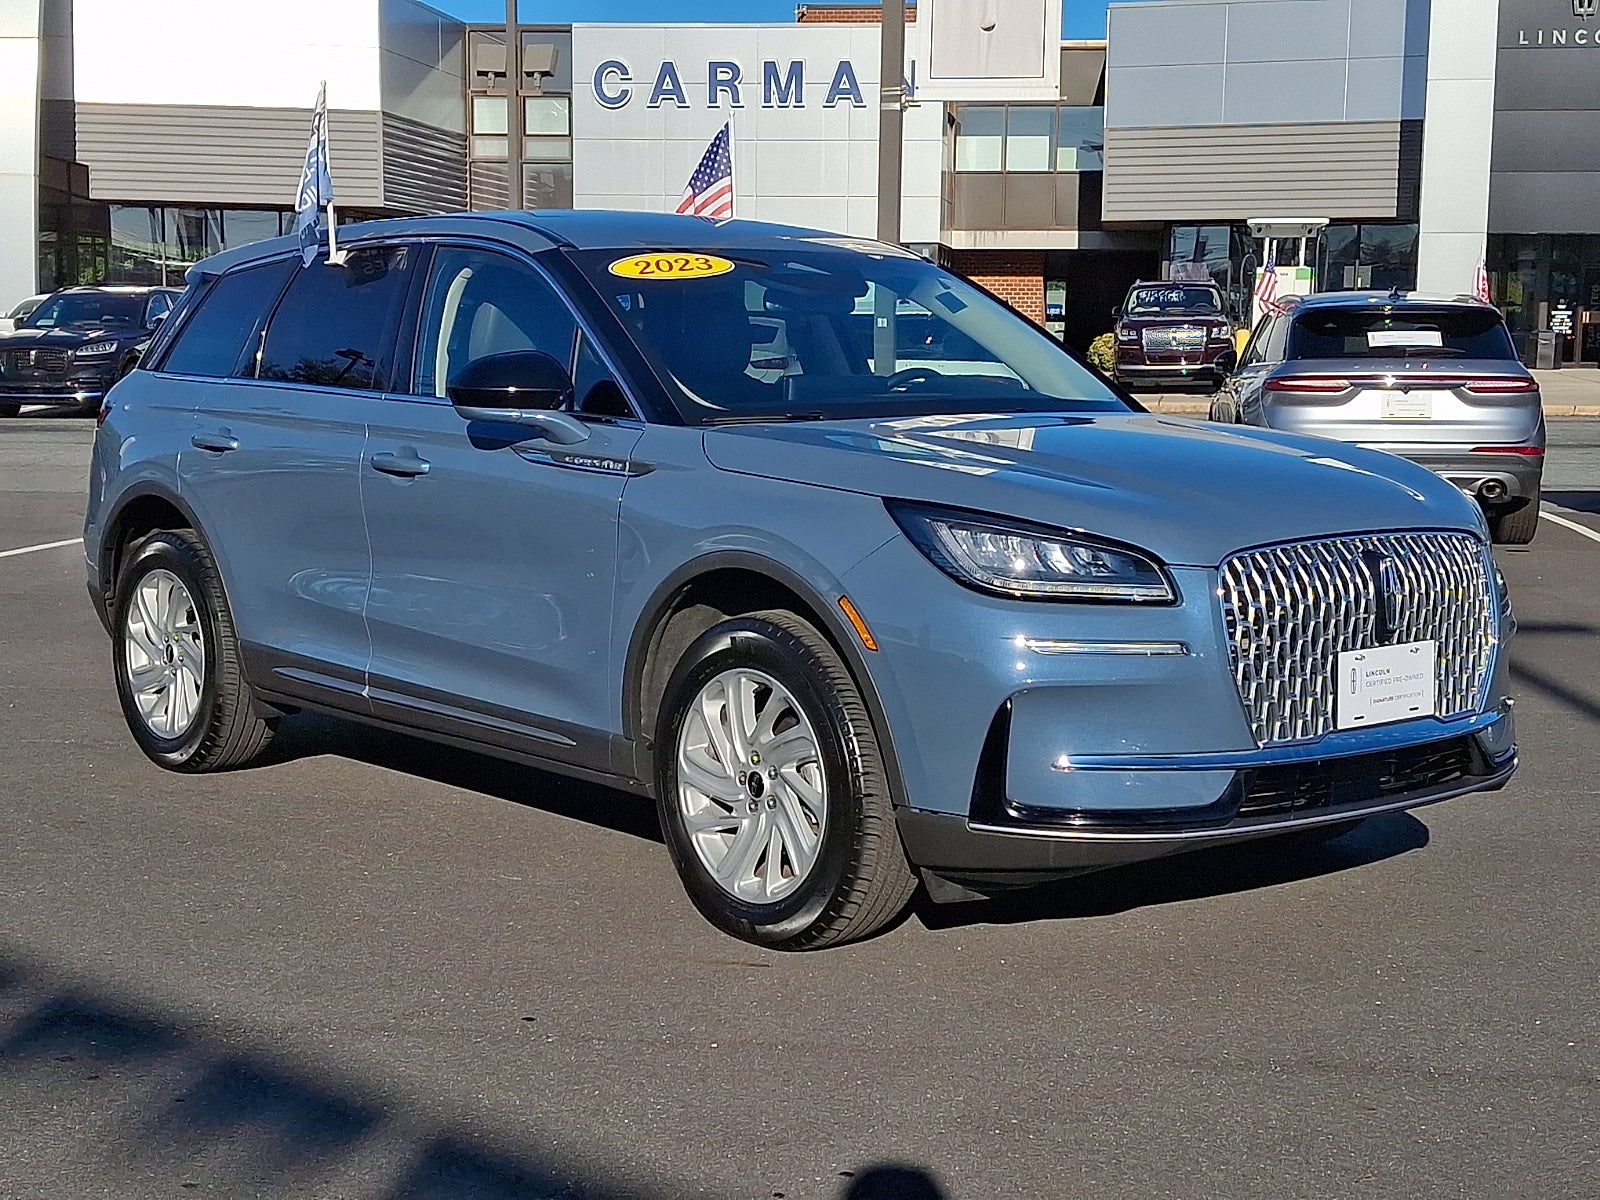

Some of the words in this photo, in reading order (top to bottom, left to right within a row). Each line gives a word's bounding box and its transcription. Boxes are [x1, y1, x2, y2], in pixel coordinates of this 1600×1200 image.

[634, 257, 713, 275] 2023
[1366, 668, 1390, 677] LINCOLN
[1366, 678, 1391, 687] CERTIFIED
